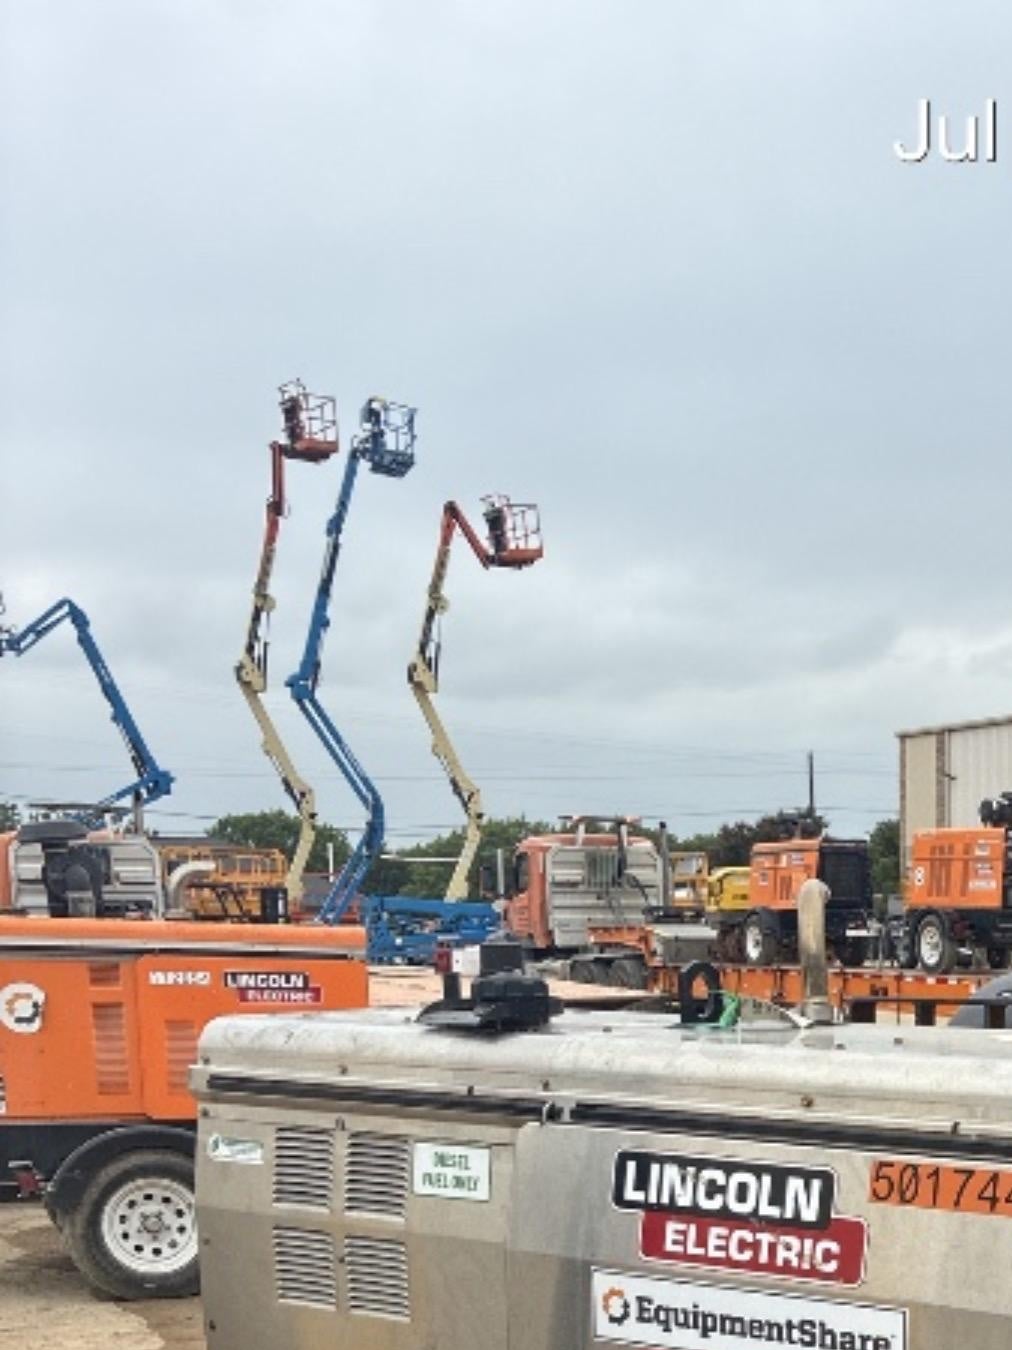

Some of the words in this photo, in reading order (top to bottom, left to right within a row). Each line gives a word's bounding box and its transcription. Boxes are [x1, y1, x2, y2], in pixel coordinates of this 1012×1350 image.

[226, 973, 305, 988] LINCOLN
[621, 1159, 823, 1224] LINCOLN
[664, 1220, 841, 1274] ELECTRIC
